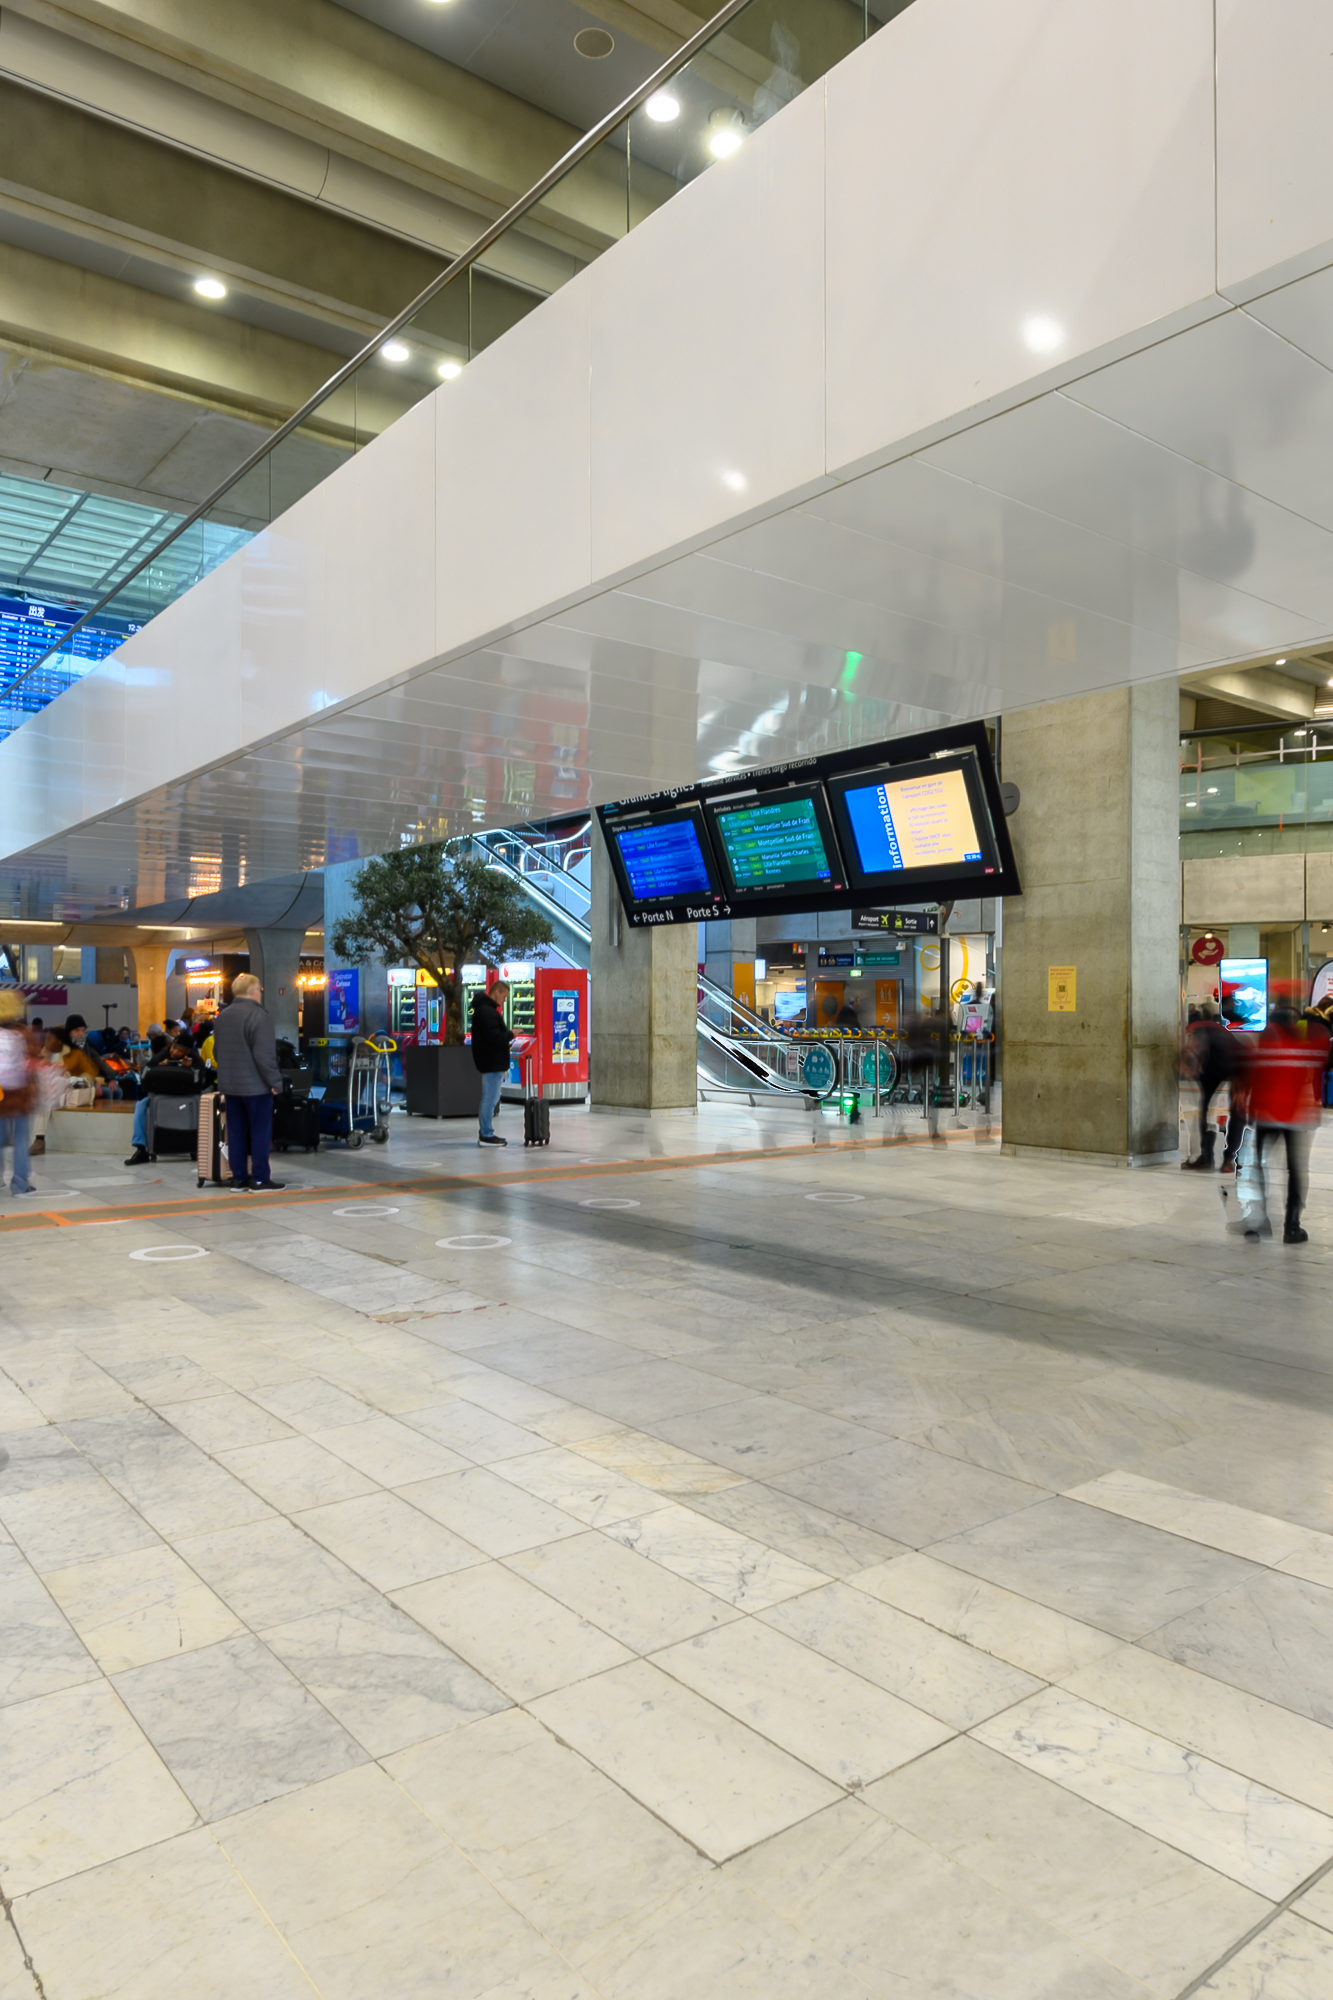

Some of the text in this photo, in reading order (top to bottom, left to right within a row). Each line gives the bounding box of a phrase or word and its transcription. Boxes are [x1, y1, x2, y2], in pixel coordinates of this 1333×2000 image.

[761, 806, 781, 816] Flandres
[754, 823, 781, 832] Montpellier
[876, 786, 902, 869] information
[758, 838, 784, 847] Montpellier
[642, 910, 674, 923] Porte N
[687, 905, 719, 918] Porte S
